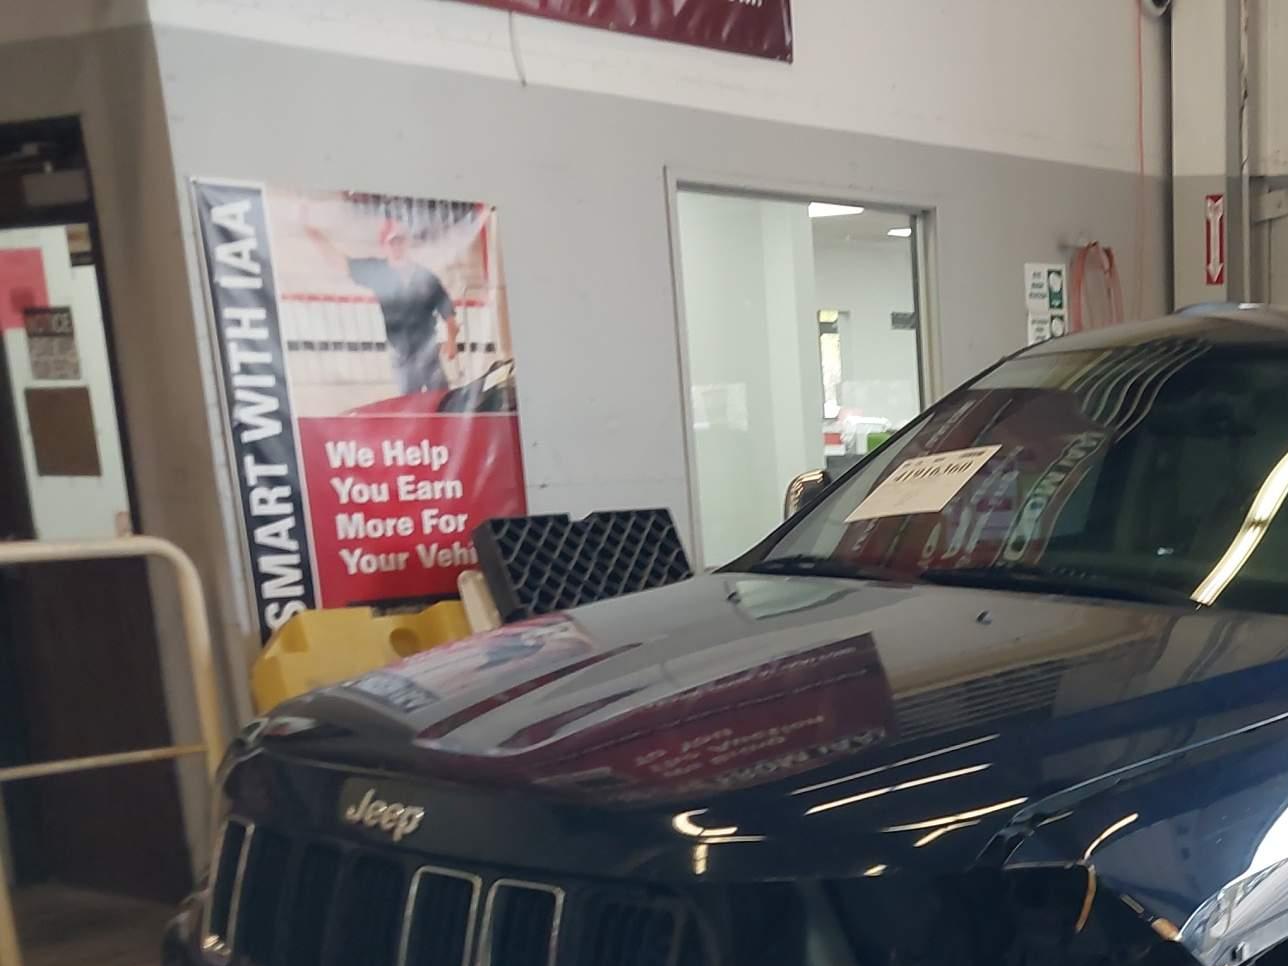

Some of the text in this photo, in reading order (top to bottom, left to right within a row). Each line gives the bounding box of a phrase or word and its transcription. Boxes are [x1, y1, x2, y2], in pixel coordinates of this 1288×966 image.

[211, 199, 307, 631] SMART WITH IAA
[325, 439, 448, 471] We Help
[330, 475, 463, 504] You Earn
[335, 508, 468, 540] More For
[339, 548, 409, 575] Your
[345, 788, 425, 843] Jeep
